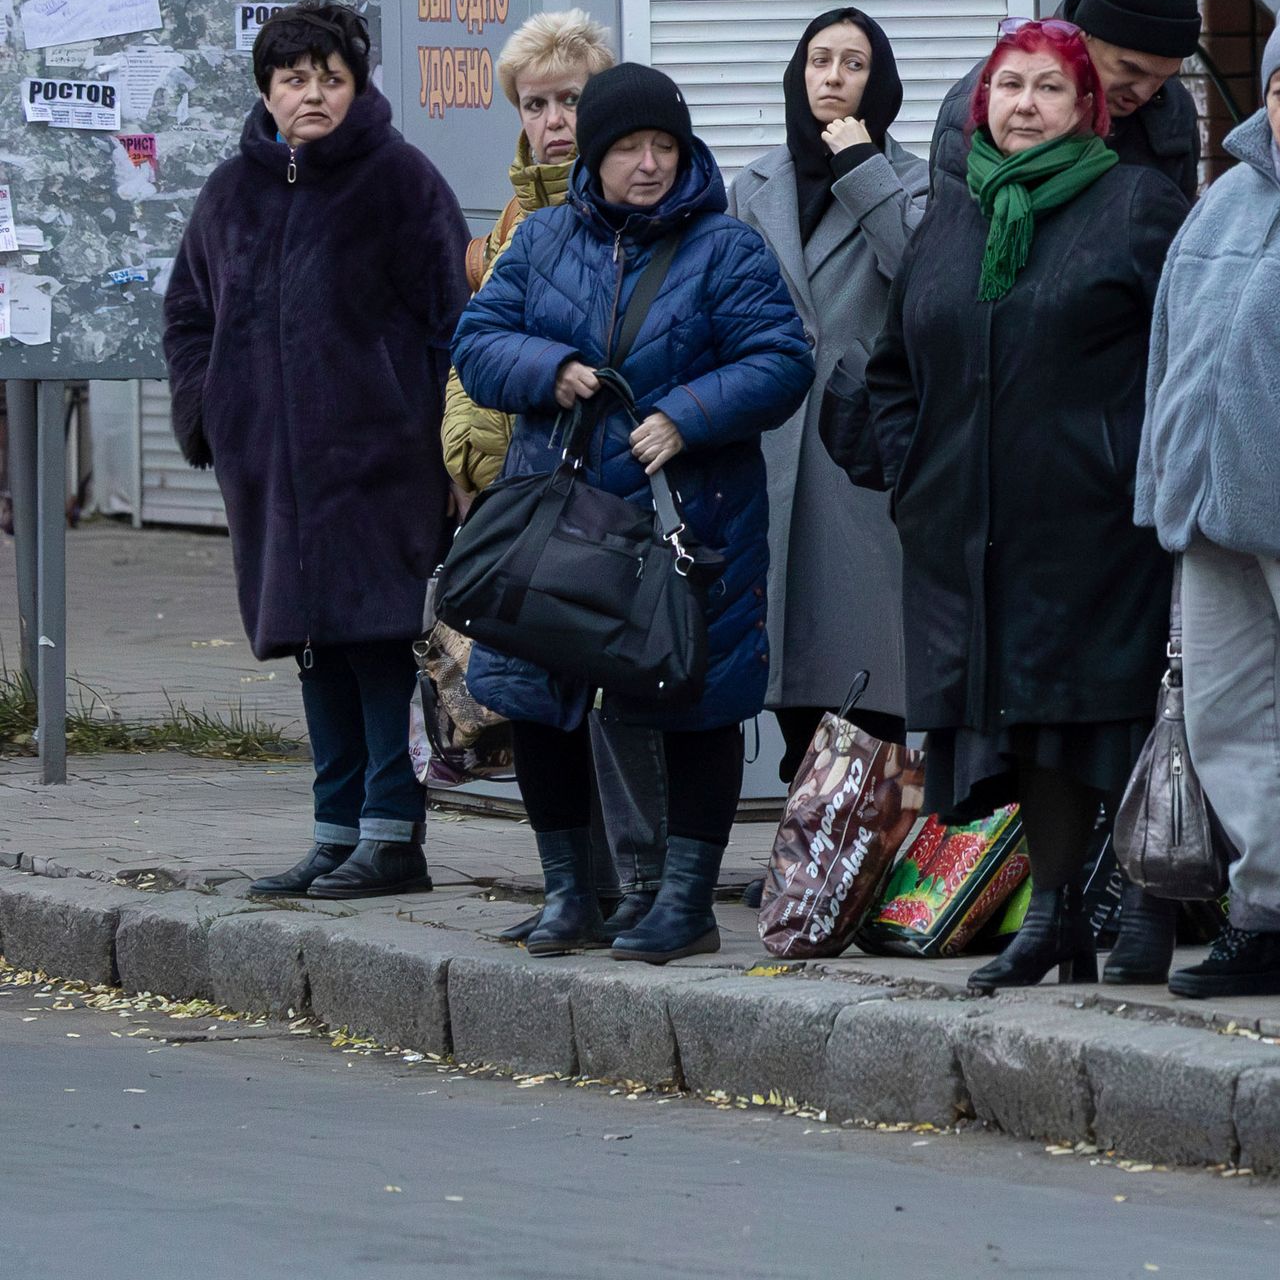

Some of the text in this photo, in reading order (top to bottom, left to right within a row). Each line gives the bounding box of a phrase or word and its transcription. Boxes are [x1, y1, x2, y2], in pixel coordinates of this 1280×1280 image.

[29, 80, 116, 109] РОСТОВ
[417, 45, 494, 119] УДОБНО
[805, 757, 864, 879] Chocolate
[808, 825, 874, 945] Chocolate
